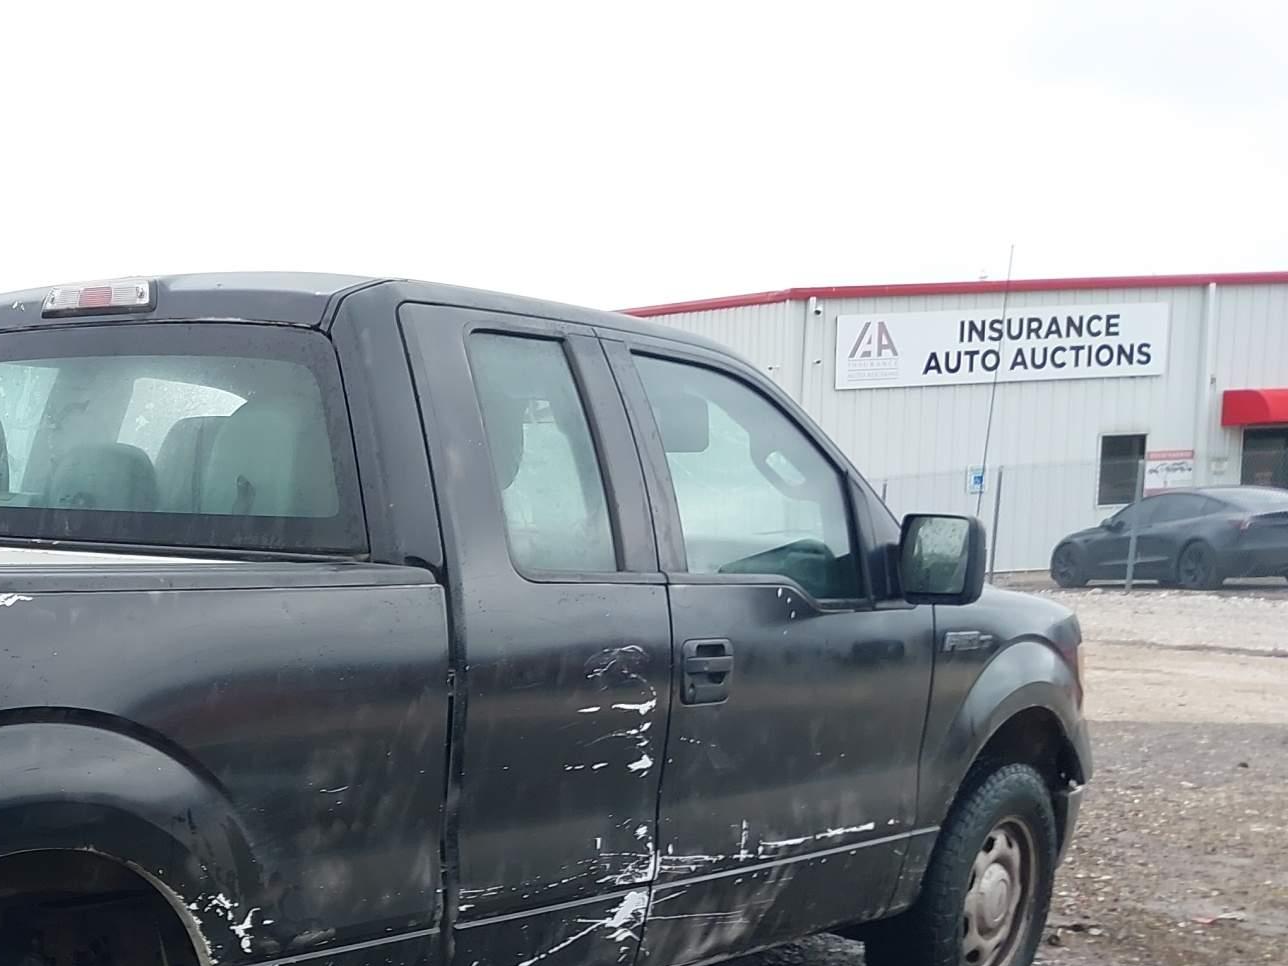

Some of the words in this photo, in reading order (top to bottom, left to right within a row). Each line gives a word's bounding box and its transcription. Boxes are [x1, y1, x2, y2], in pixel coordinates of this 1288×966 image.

[958, 313, 1121, 344] INSURANCE
[922, 350, 1001, 376] AUTO
[1008, 342, 1152, 372] AUCTIONS
